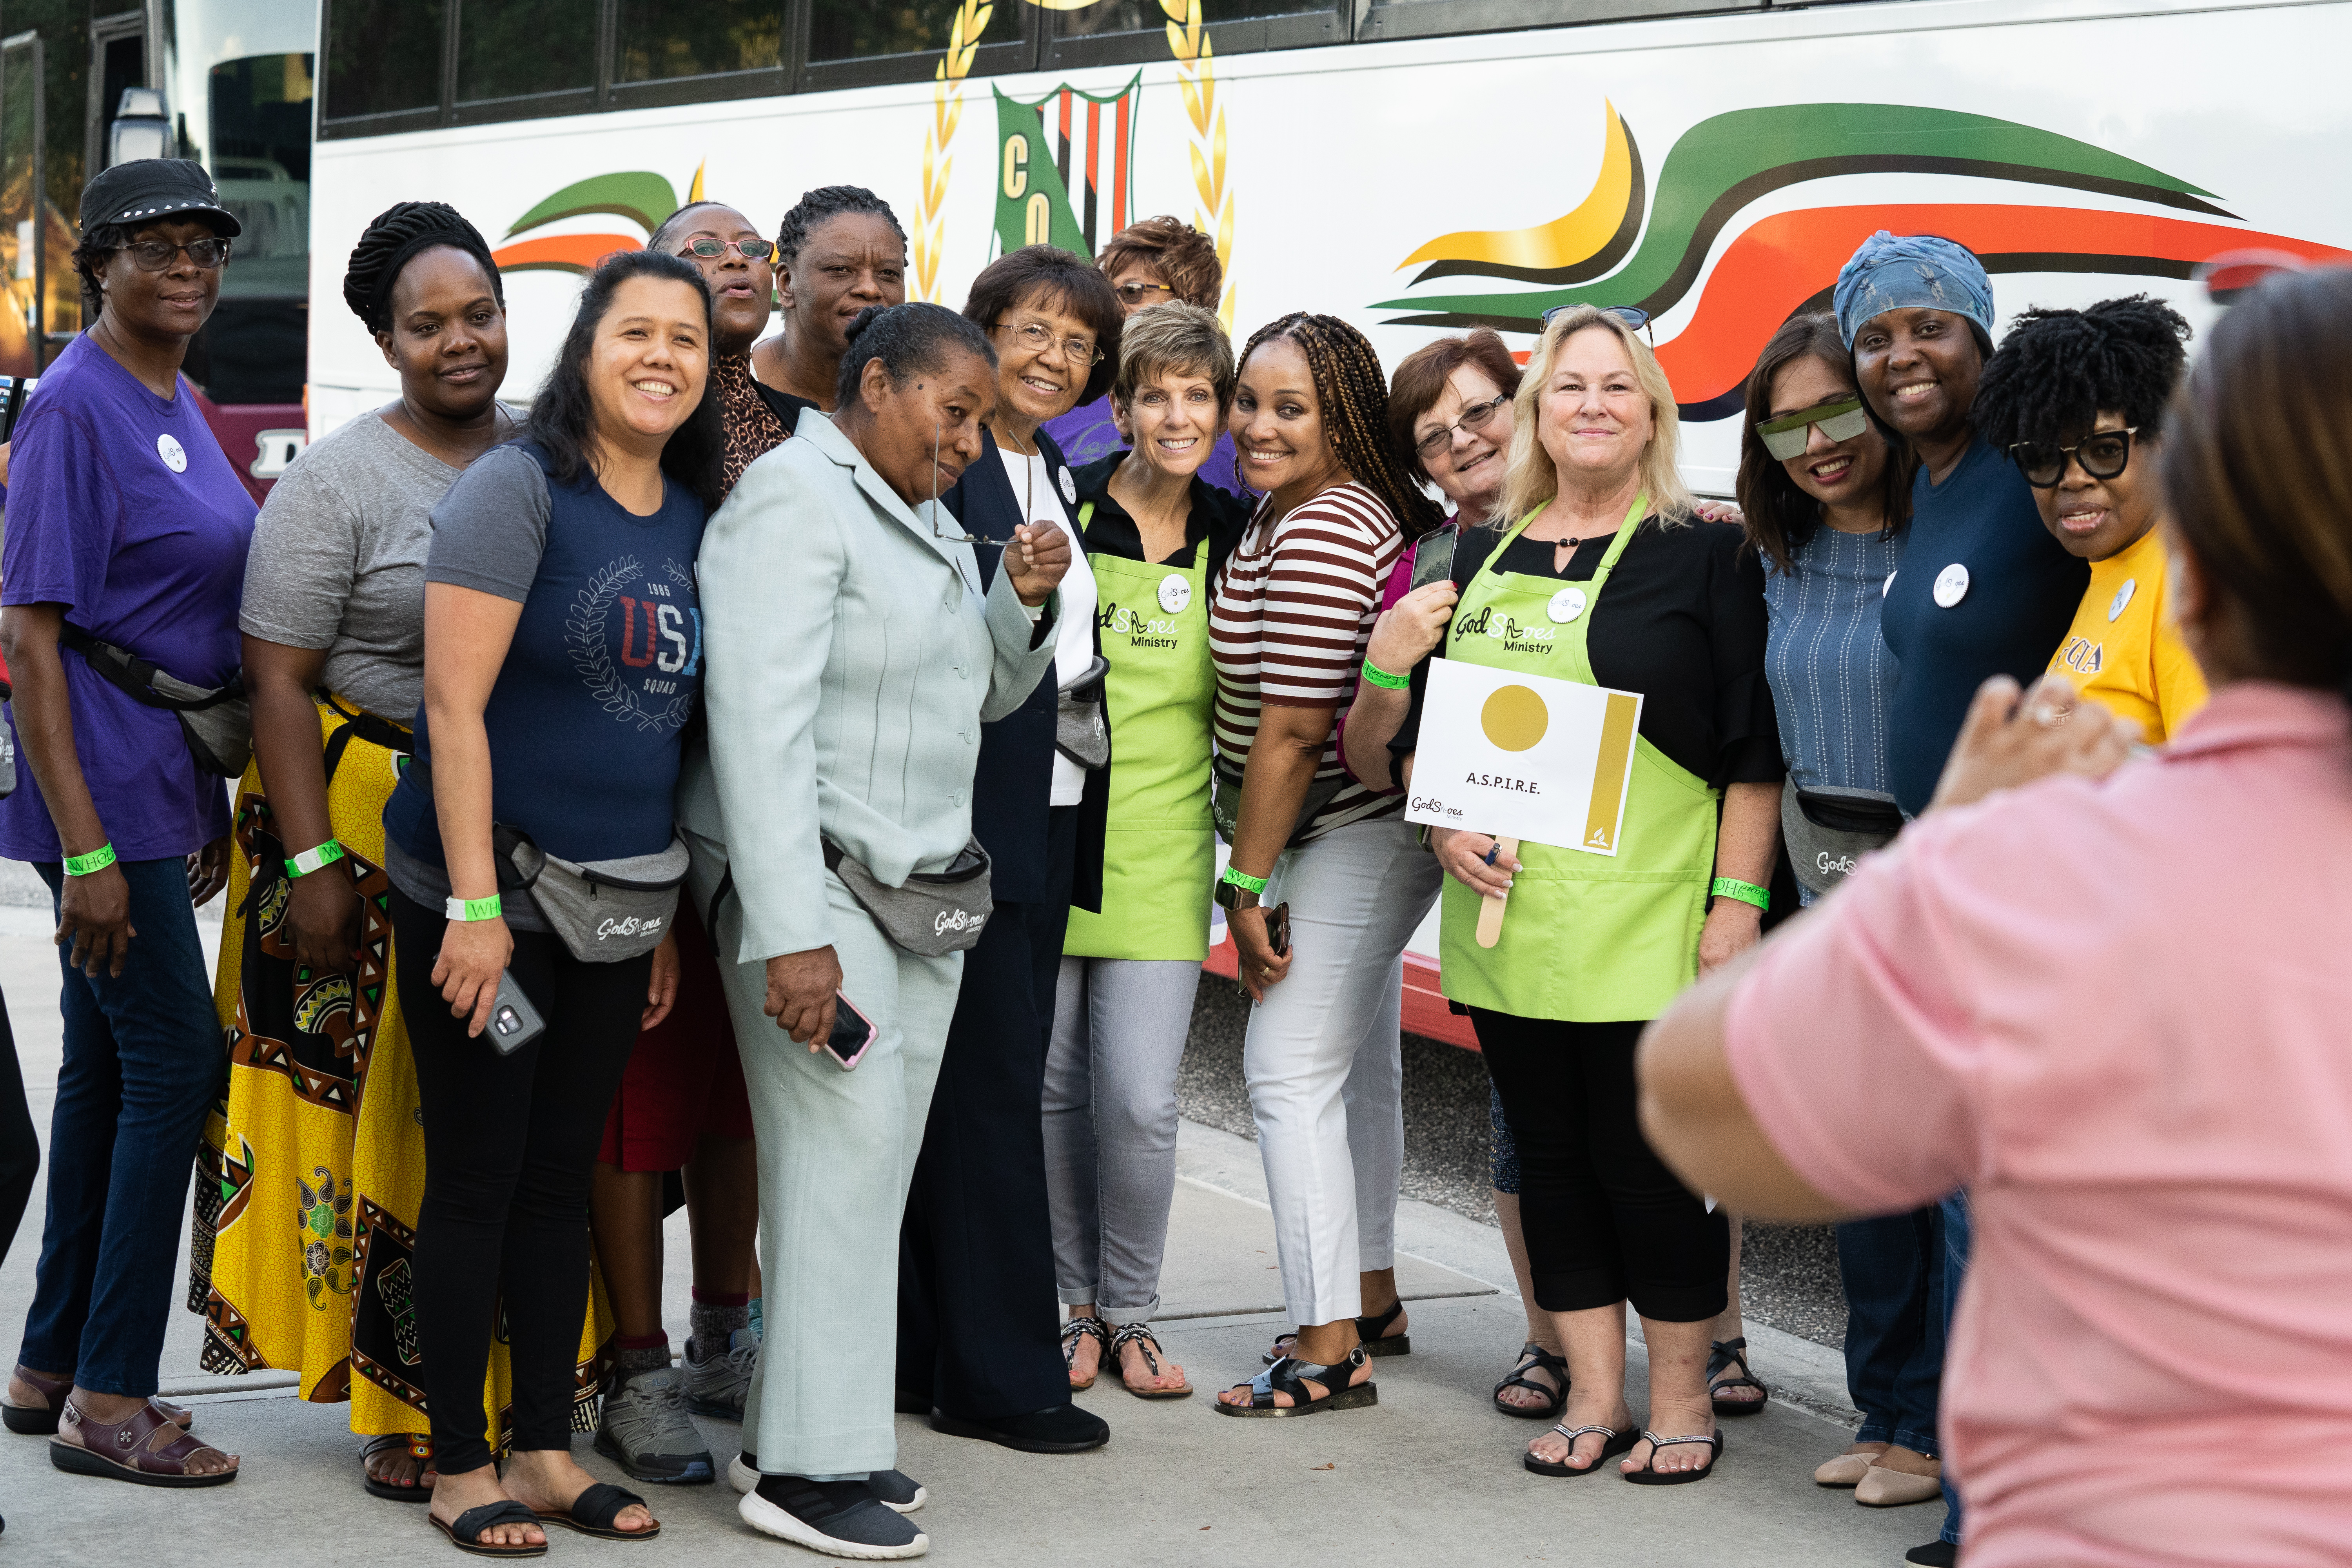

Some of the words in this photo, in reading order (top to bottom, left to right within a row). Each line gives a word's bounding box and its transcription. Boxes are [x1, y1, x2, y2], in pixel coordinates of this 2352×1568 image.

[647, 583, 671, 597] 1985
[1131, 636, 1178, 650] Ministry
[1504, 641, 1553, 654] Ministry
[643, 678, 677, 694] SQUAD
[1466, 772, 1540, 795] A.S.P.I.R.E.
[639, 928, 660, 937] Ministry
